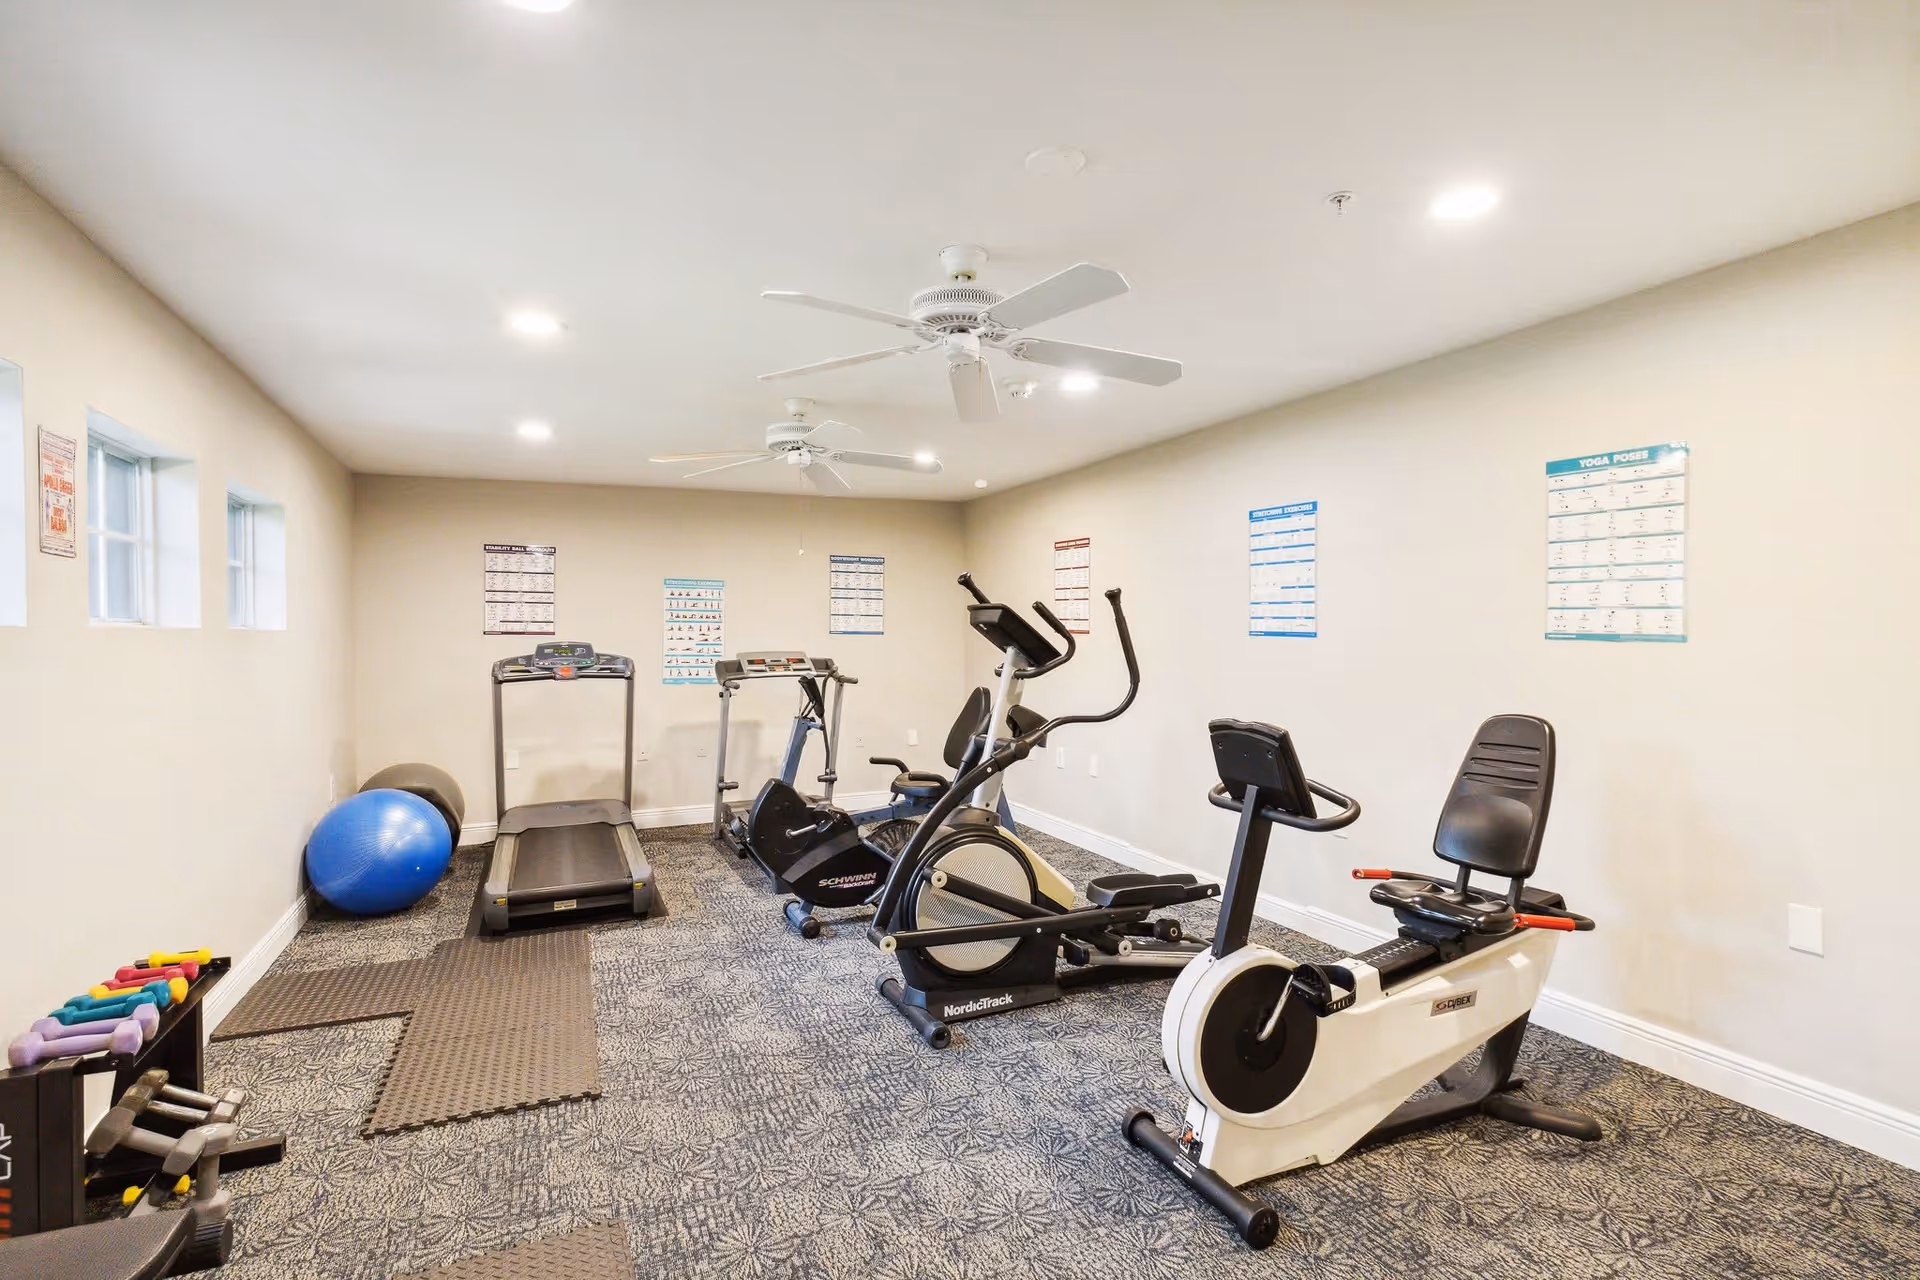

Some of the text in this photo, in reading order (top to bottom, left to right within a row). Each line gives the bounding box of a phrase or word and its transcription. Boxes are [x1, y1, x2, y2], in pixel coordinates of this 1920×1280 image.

[1579, 451, 1648, 468] YOGA POSES
[818, 872, 877, 887] SCHWINN
[944, 993, 1013, 1017] NordicTrack
[1448, 995, 1472, 1009] CYBEX
